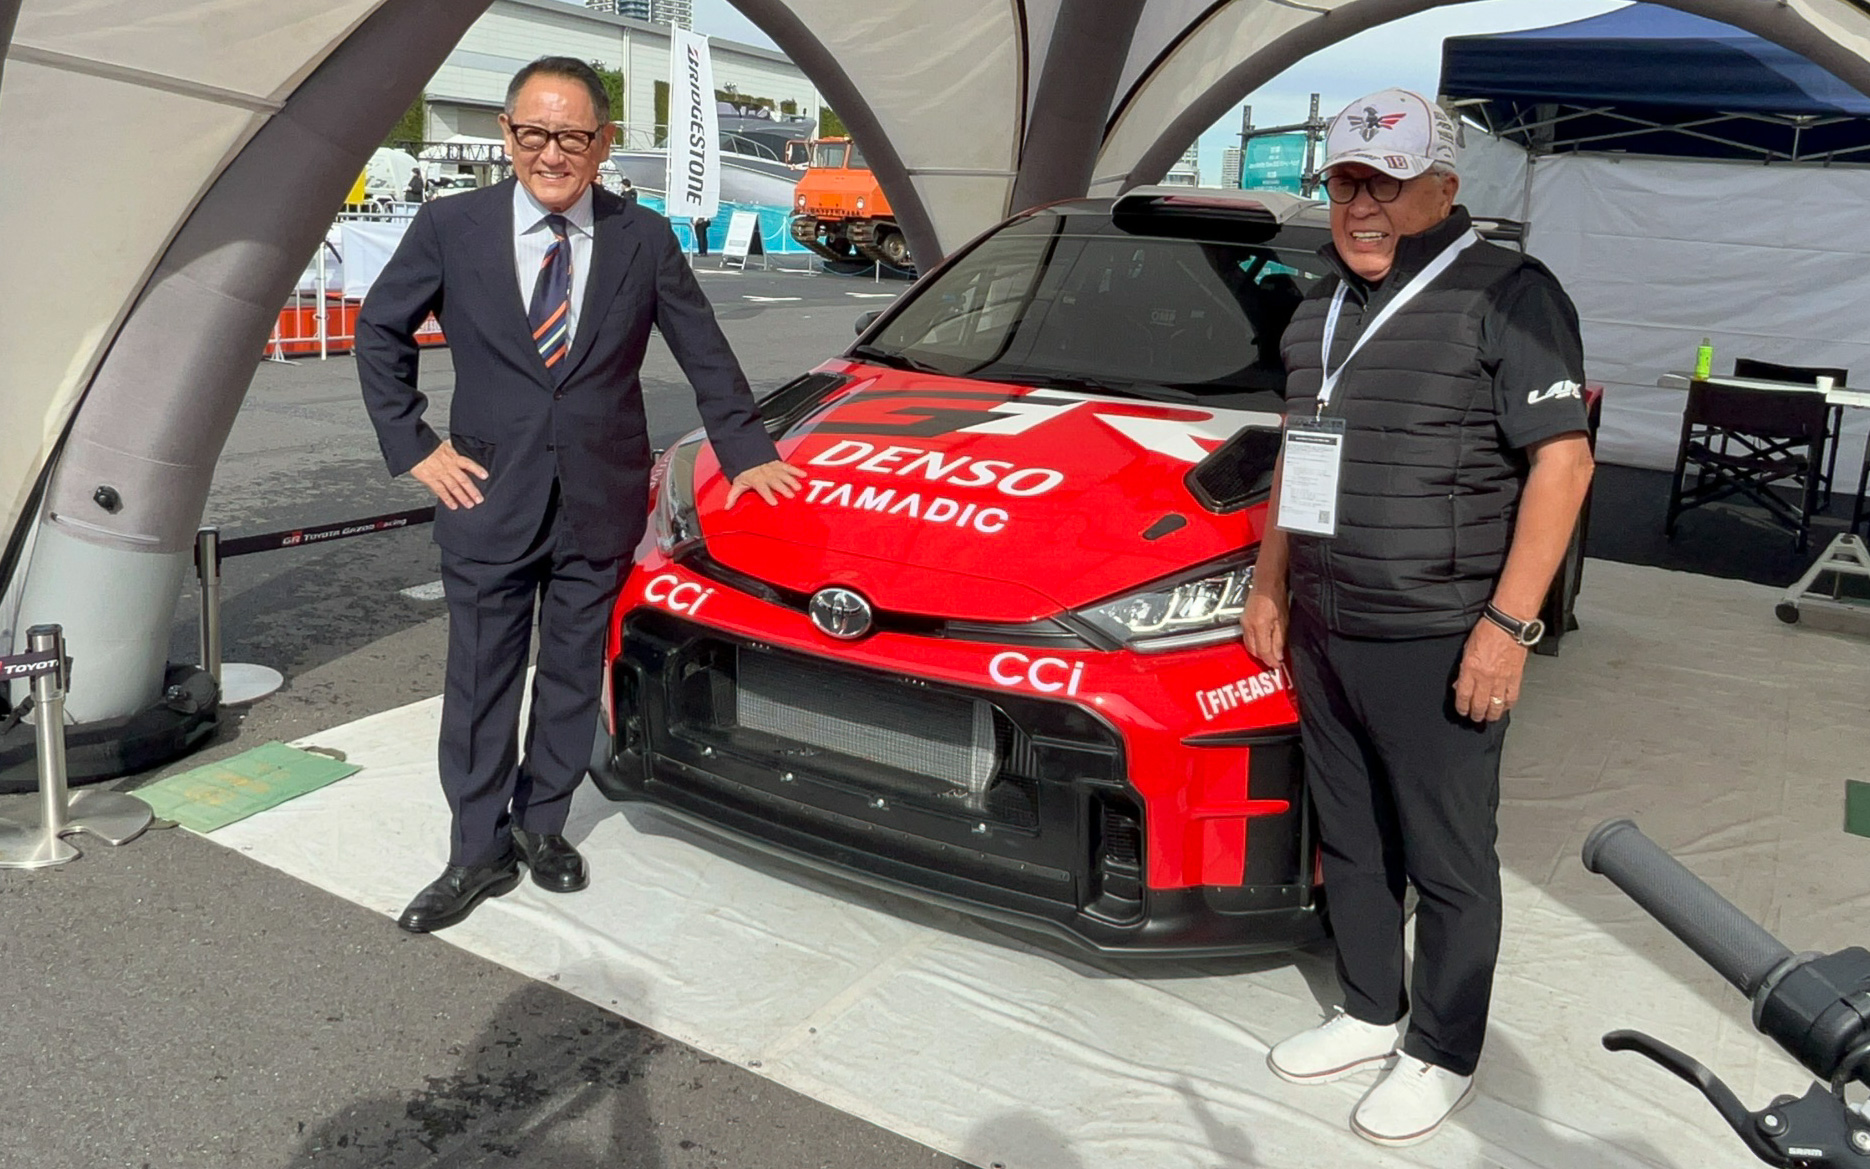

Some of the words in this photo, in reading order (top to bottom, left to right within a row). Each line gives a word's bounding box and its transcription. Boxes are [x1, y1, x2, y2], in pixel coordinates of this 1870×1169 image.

[686, 43, 707, 206] BRIDGESTONE
[807, 439, 1064, 497] DENSO
[805, 479, 1010, 534] TAMADIC
[281, 533, 302, 546] GR
[303, 529, 341, 542] TOYOTA
